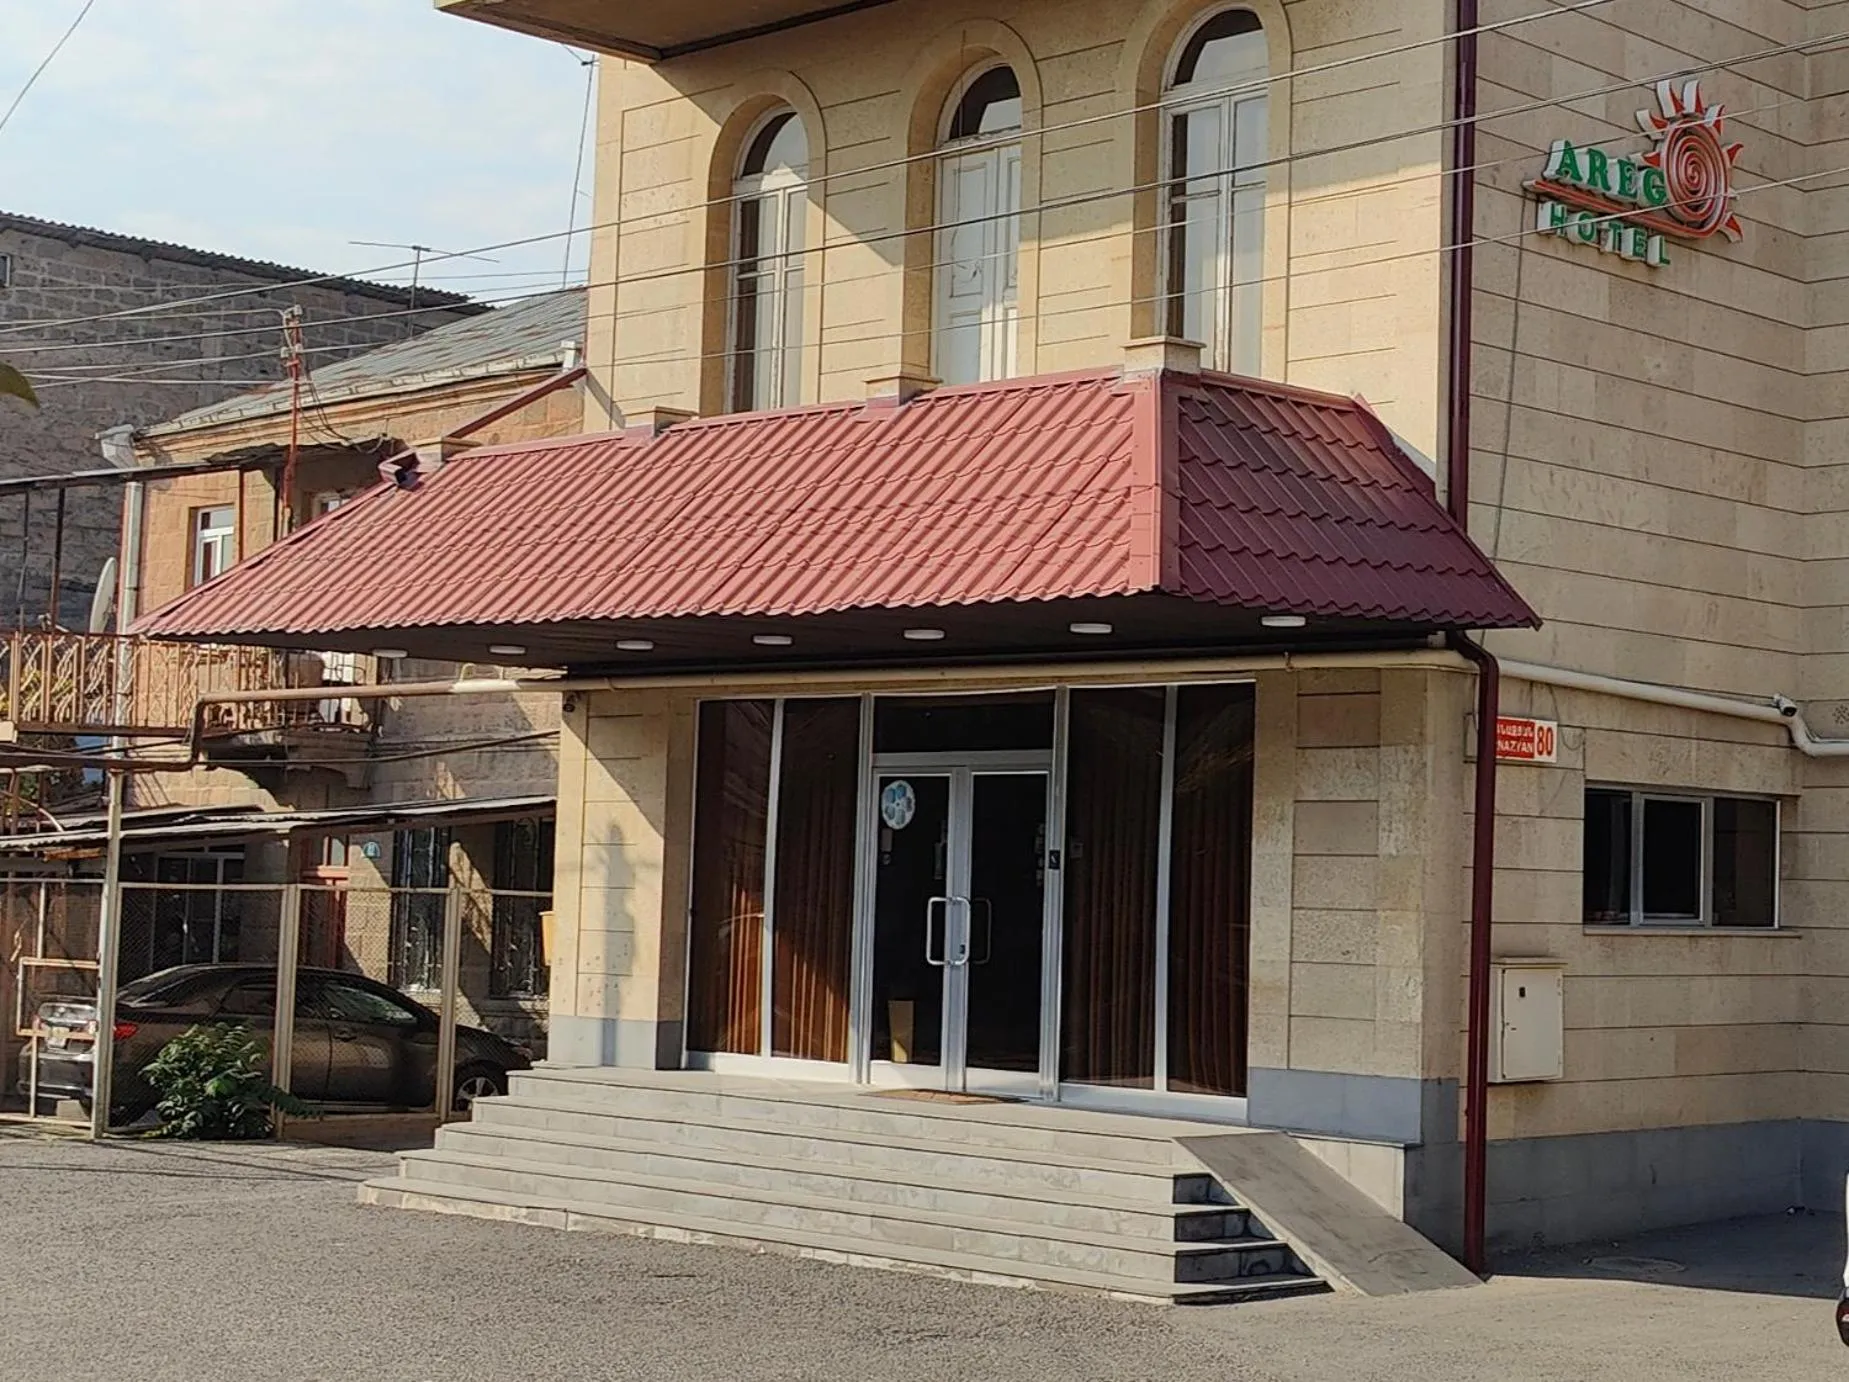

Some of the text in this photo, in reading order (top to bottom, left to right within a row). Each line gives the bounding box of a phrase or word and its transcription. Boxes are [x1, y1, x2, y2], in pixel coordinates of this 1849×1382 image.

[1549, 140, 1668, 206] AREG
[1543, 202, 1670, 266] HOTEL
[1497, 740, 1533, 753] NAZYAN
[1537, 725, 1554, 757] 80
